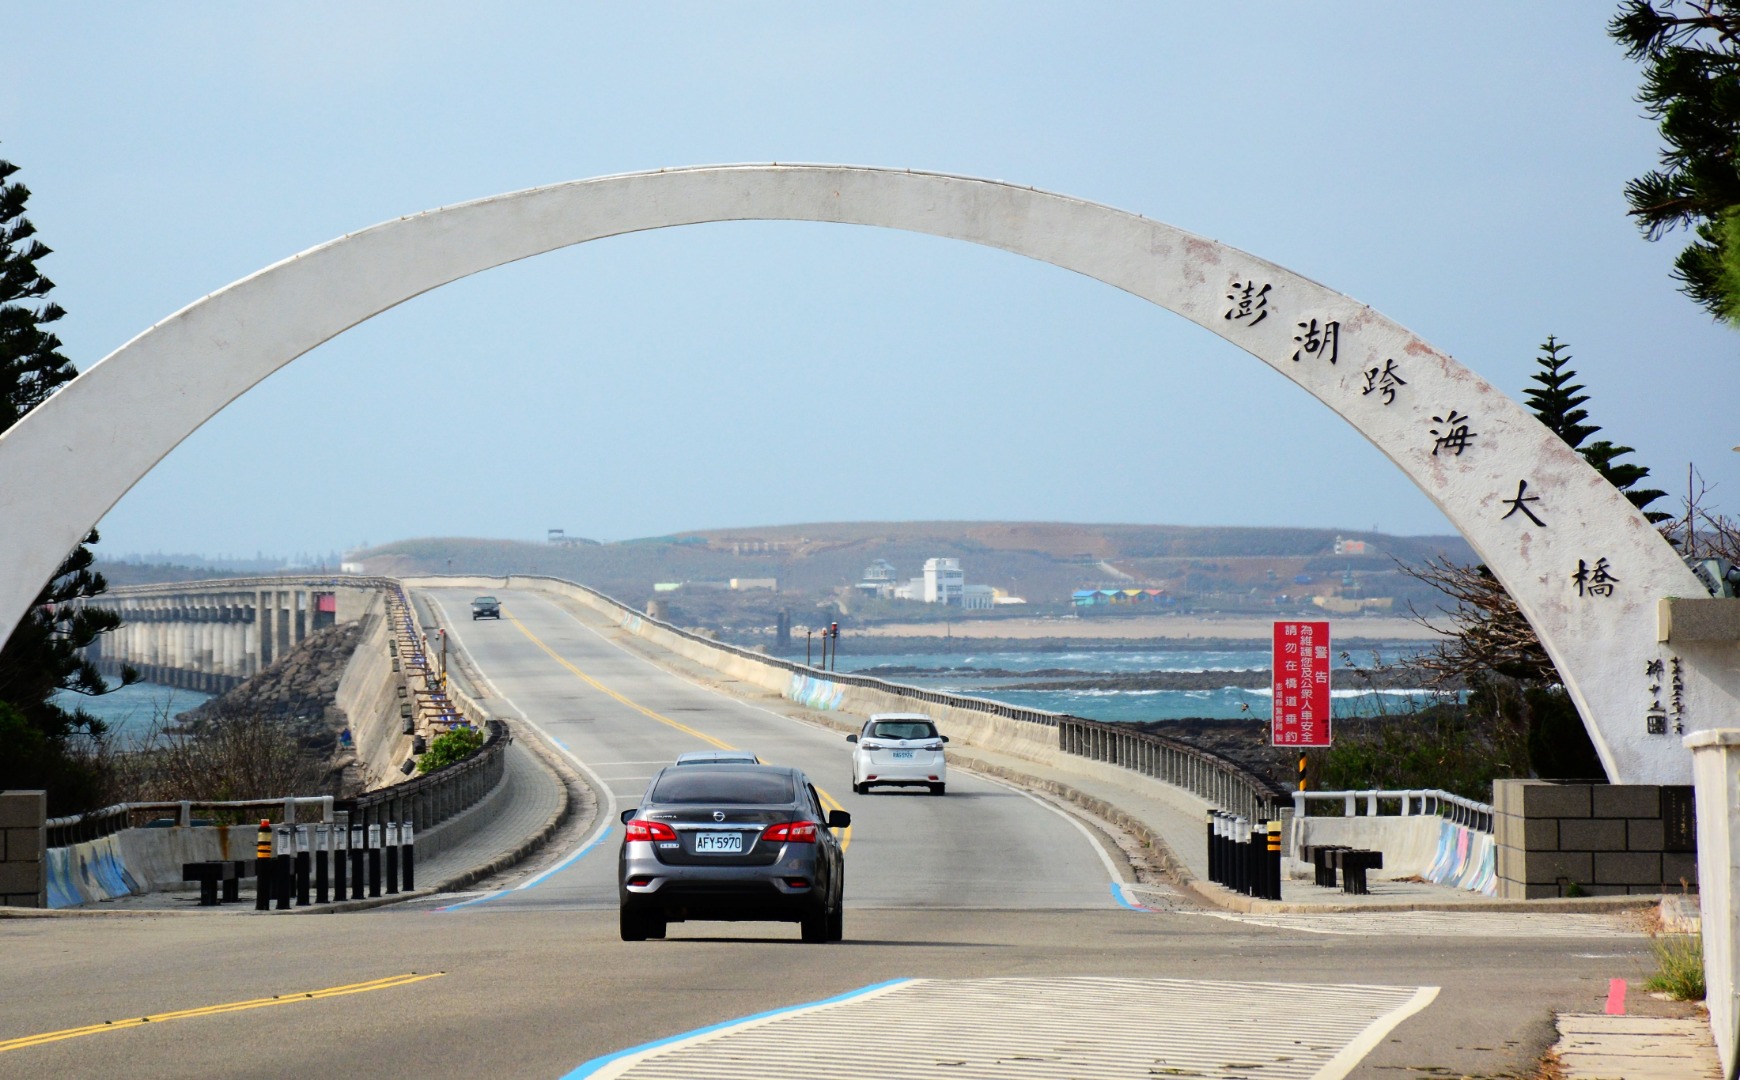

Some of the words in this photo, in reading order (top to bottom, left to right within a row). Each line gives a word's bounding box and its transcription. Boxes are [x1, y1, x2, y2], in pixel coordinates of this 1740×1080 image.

[1224, 280, 1620, 597] 澎湖跨海大橋
[1315, 646, 1327, 683] 警告
[697, 836, 741, 849] AFY-5970
